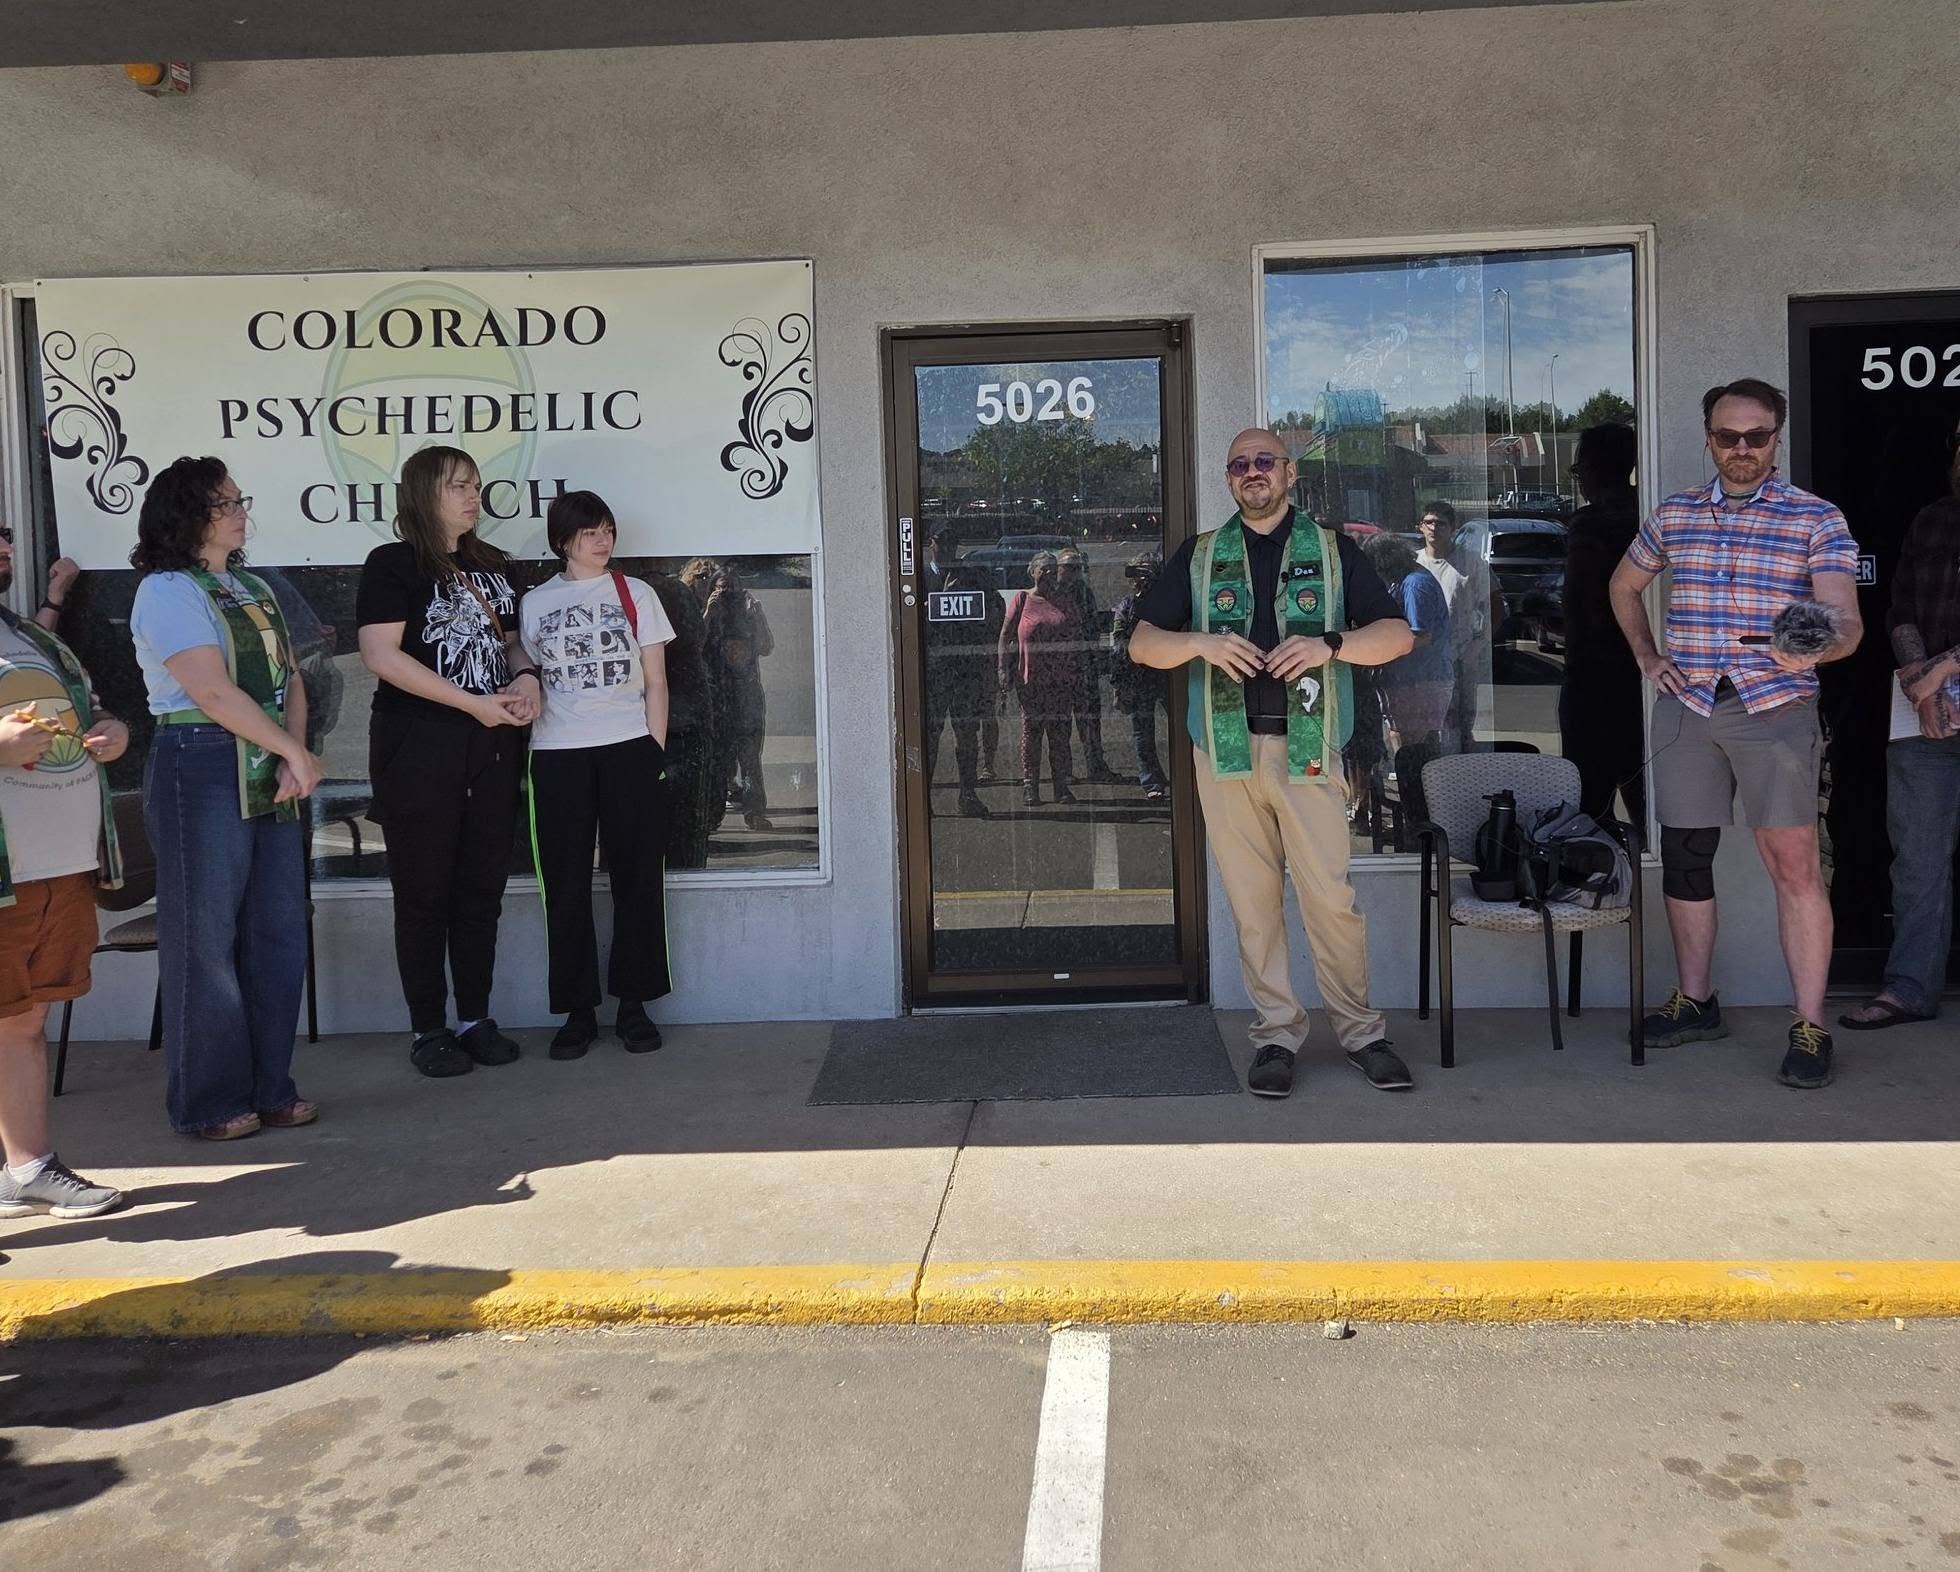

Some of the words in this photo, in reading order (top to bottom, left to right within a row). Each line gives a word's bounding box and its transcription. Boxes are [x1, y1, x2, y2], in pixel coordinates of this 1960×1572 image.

[248, 306, 606, 351] COLORADO
[218, 391, 642, 439] PSYCHEDELIC
[977, 377, 1095, 425] 5026
[300, 478, 568, 524] CHCH
[902, 523, 912, 562] PULL
[940, 596, 974, 616] EXIT
[4, 775, 64, 792] Community
